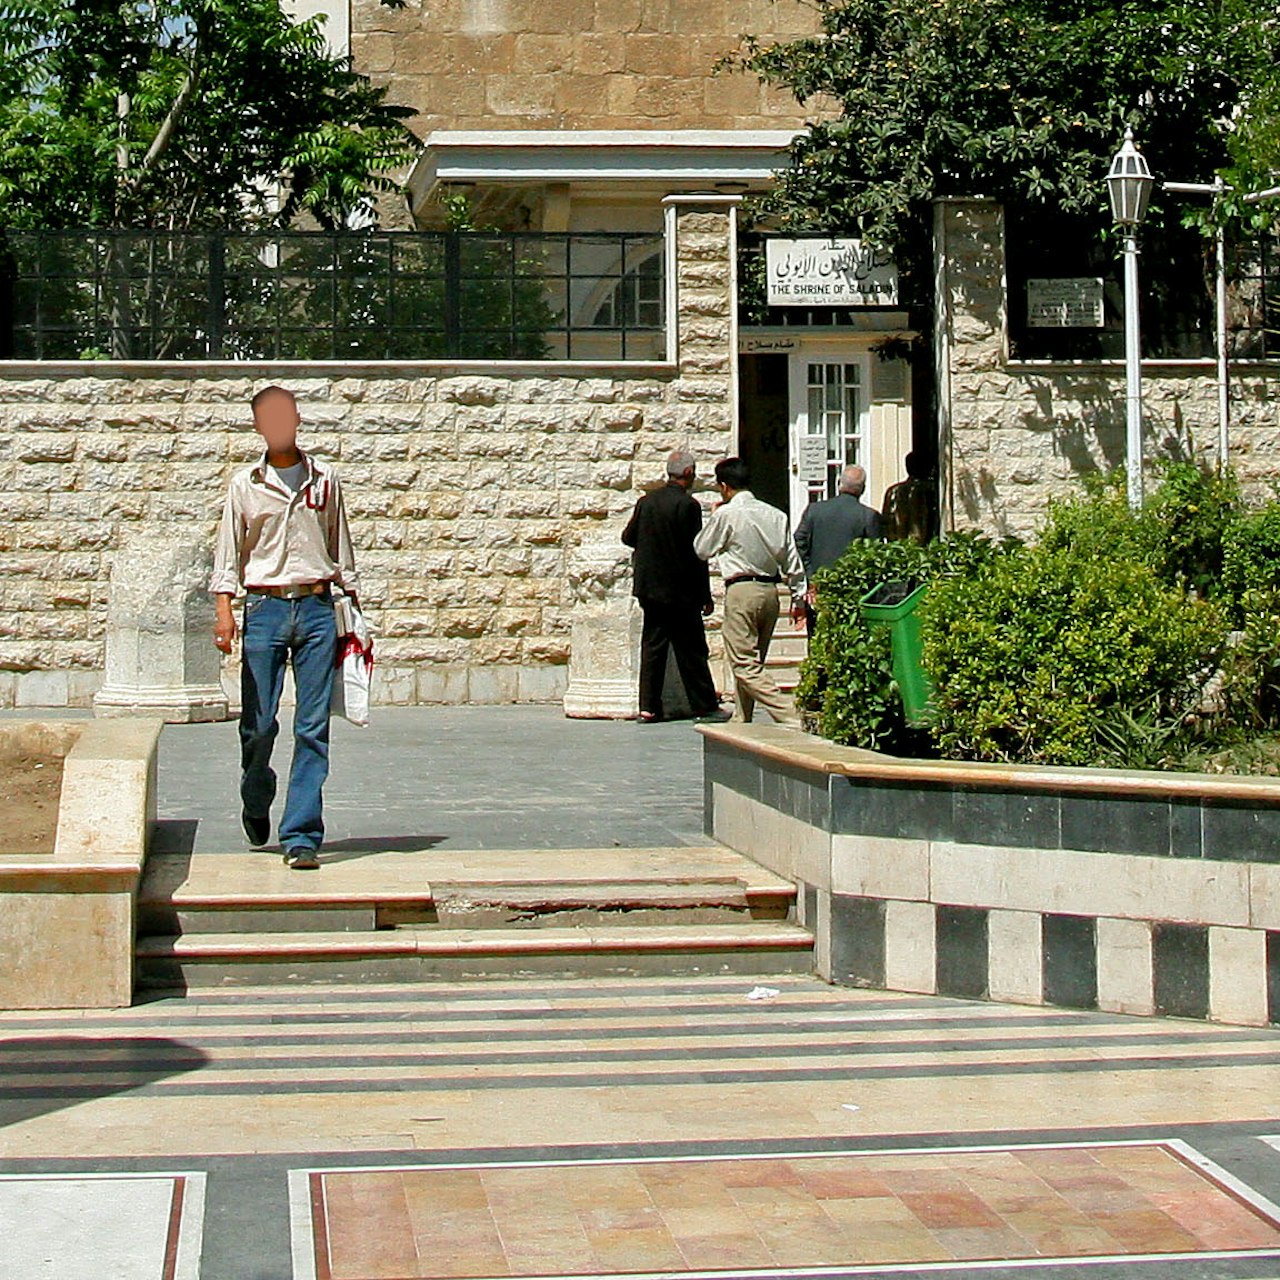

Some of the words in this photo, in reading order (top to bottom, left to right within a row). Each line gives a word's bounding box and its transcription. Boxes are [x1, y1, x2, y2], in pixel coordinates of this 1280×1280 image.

[771, 284, 791, 295] THE
[793, 284, 831, 295] SHRINE
[833, 284, 845, 295] OF
